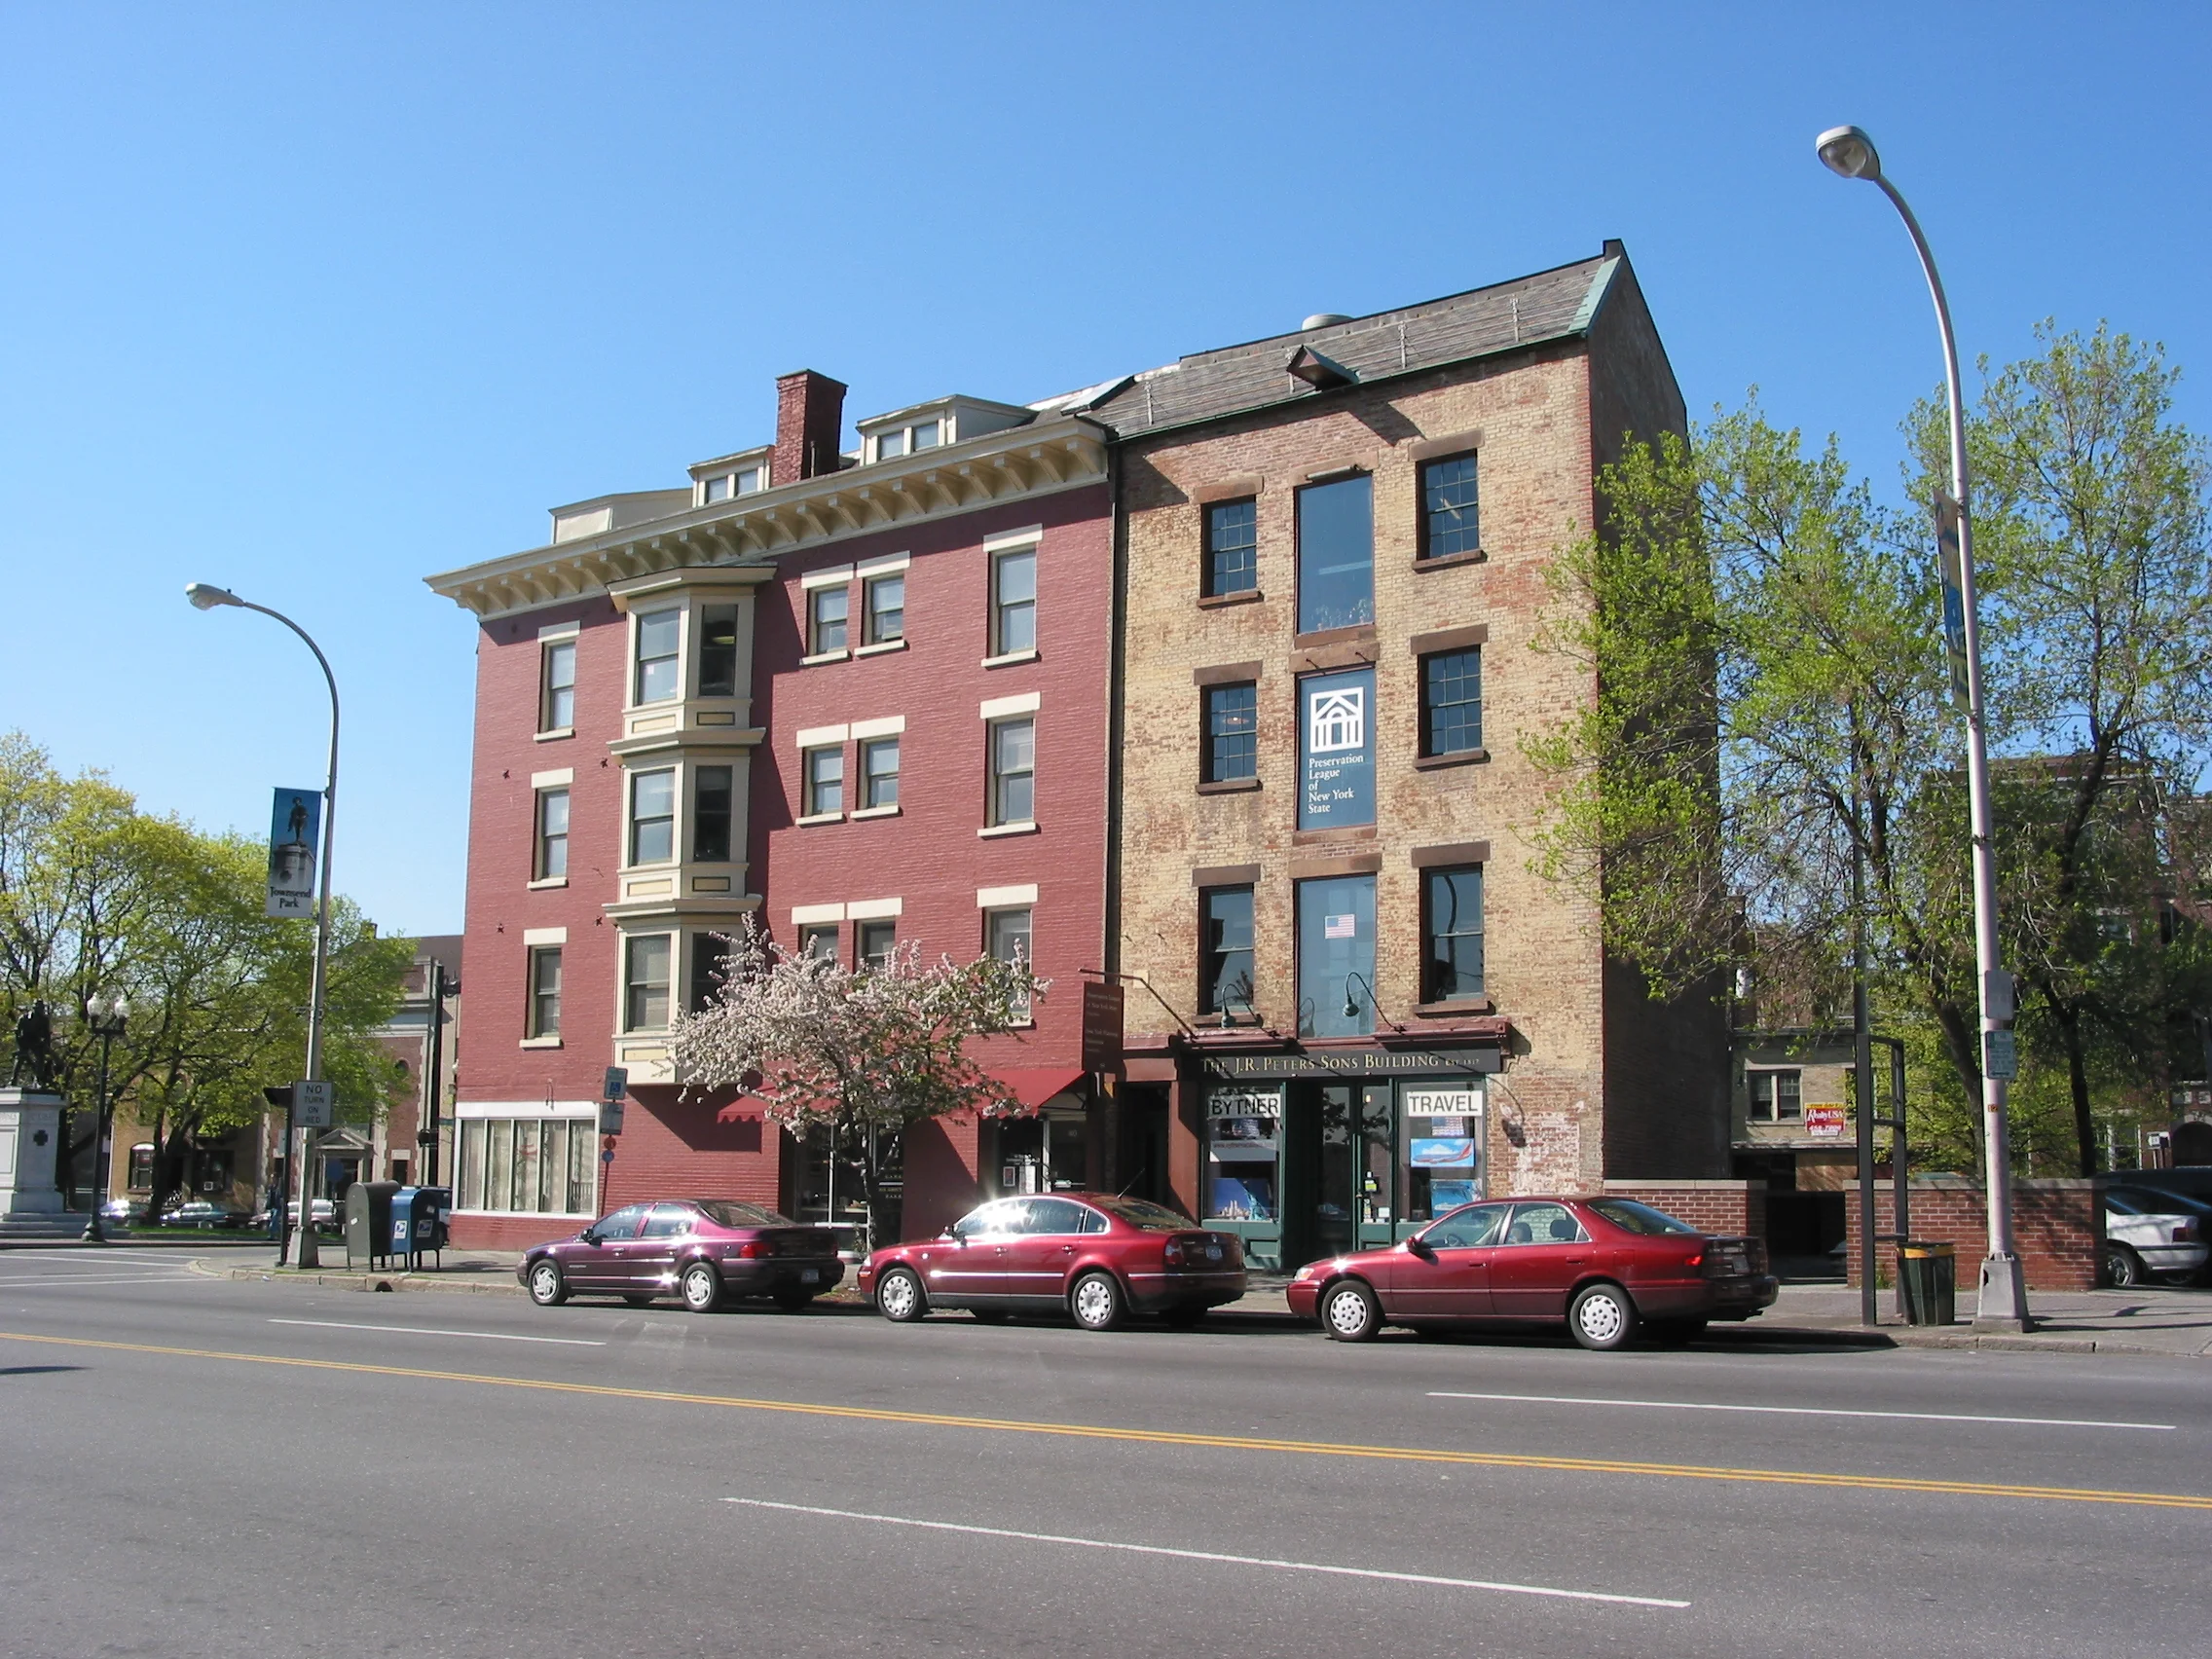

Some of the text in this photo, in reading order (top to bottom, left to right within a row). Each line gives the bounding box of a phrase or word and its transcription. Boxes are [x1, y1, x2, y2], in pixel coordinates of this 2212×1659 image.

[1309, 754, 1363, 768] Preservation
[1309, 769, 1340, 780] League
[1308, 779, 1319, 791] of
[1308, 788, 1354, 802] New York
[1308, 803, 1332, 814] State
[270, 886, 312, 899] Townsend
[279, 897, 300, 908] Park
[1364, 1053, 1439, 1069] BUILDING
[306, 1085, 322, 1094] NO
[304, 1095, 324, 1104] TURN
[1409, 1095, 1478, 1112] TRAVEL
[1211, 1097, 1279, 1116] BYTNER
[305, 1115, 321, 1124] RED
